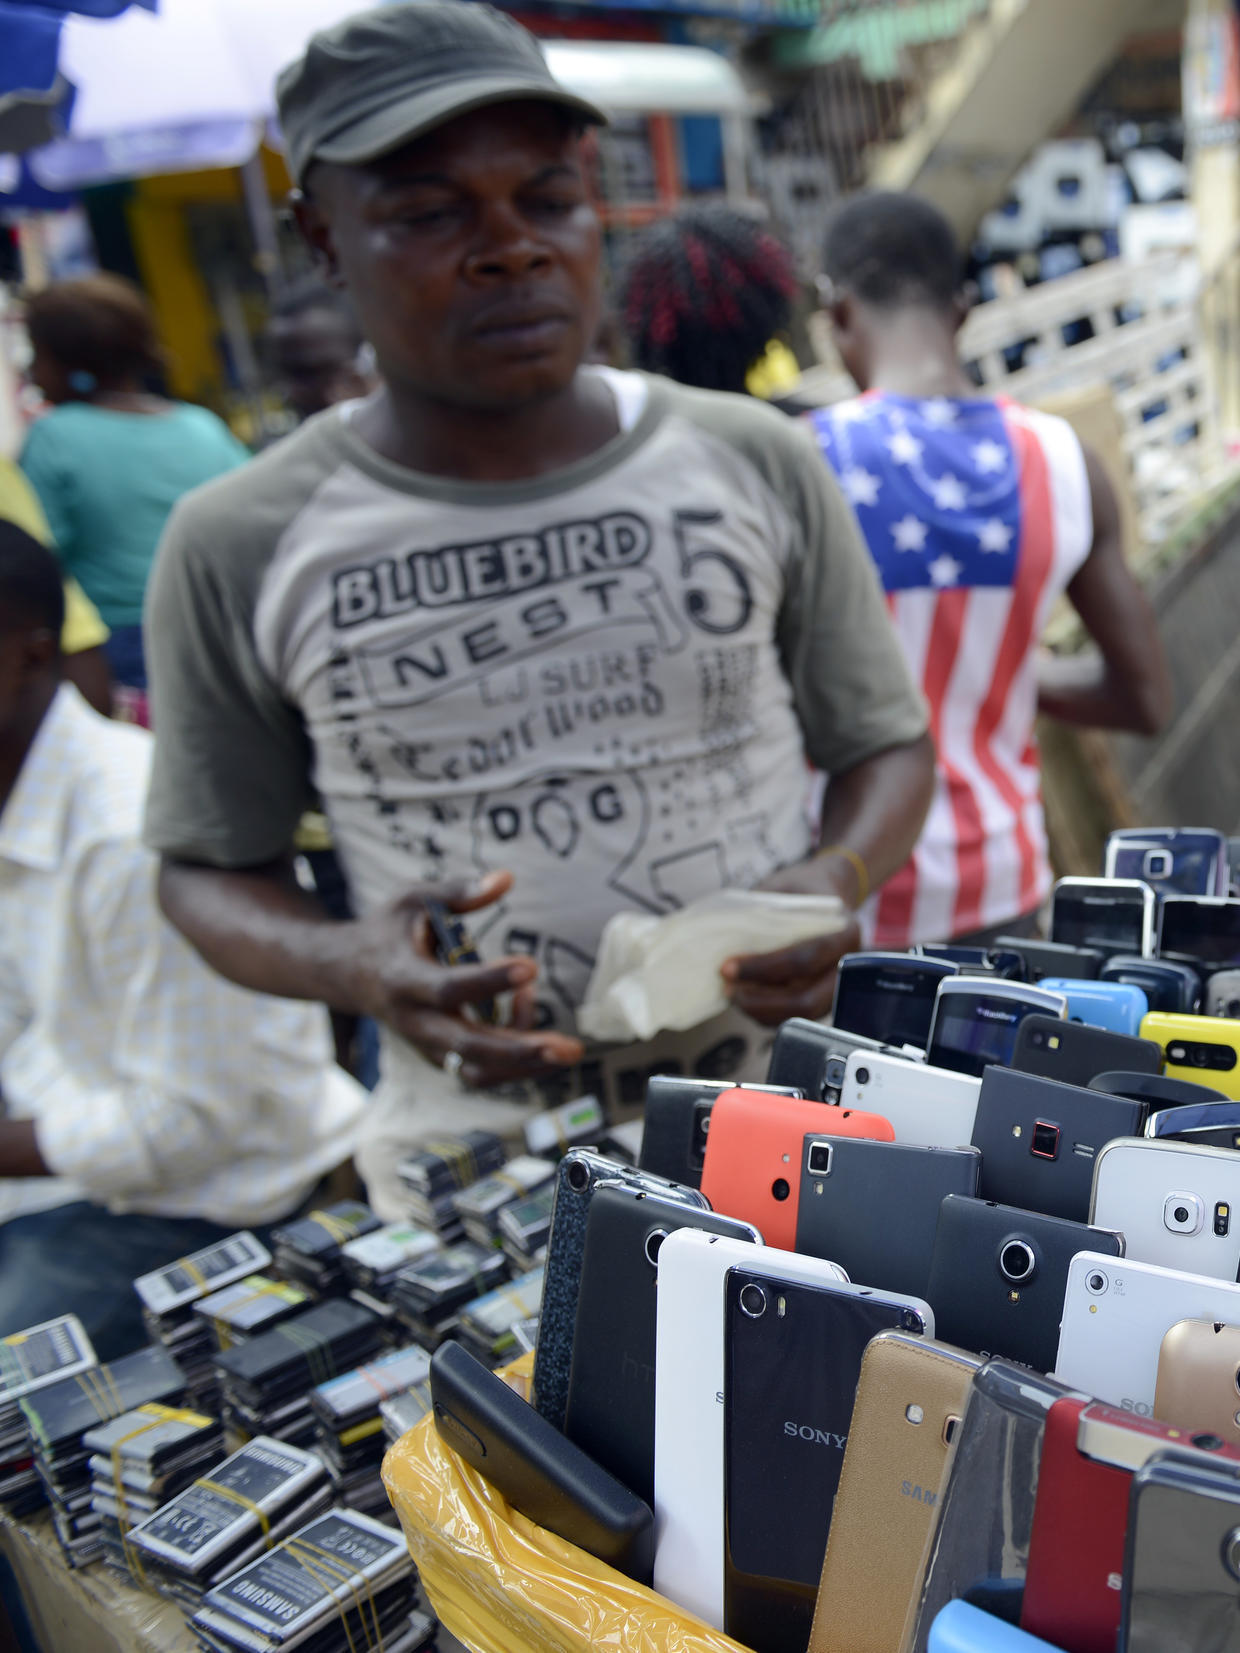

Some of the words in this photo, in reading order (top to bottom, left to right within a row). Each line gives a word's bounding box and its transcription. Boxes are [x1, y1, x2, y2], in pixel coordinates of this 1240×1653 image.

[332, 510, 654, 630] BLUEBIRD
[674, 510, 753, 635] 5
[393, 577, 621, 690] NEST
[783, 1421, 847, 1450] SONY
[1121, 1398, 1154, 1417] SO
[231, 1579, 300, 1621] SAMSUNG
